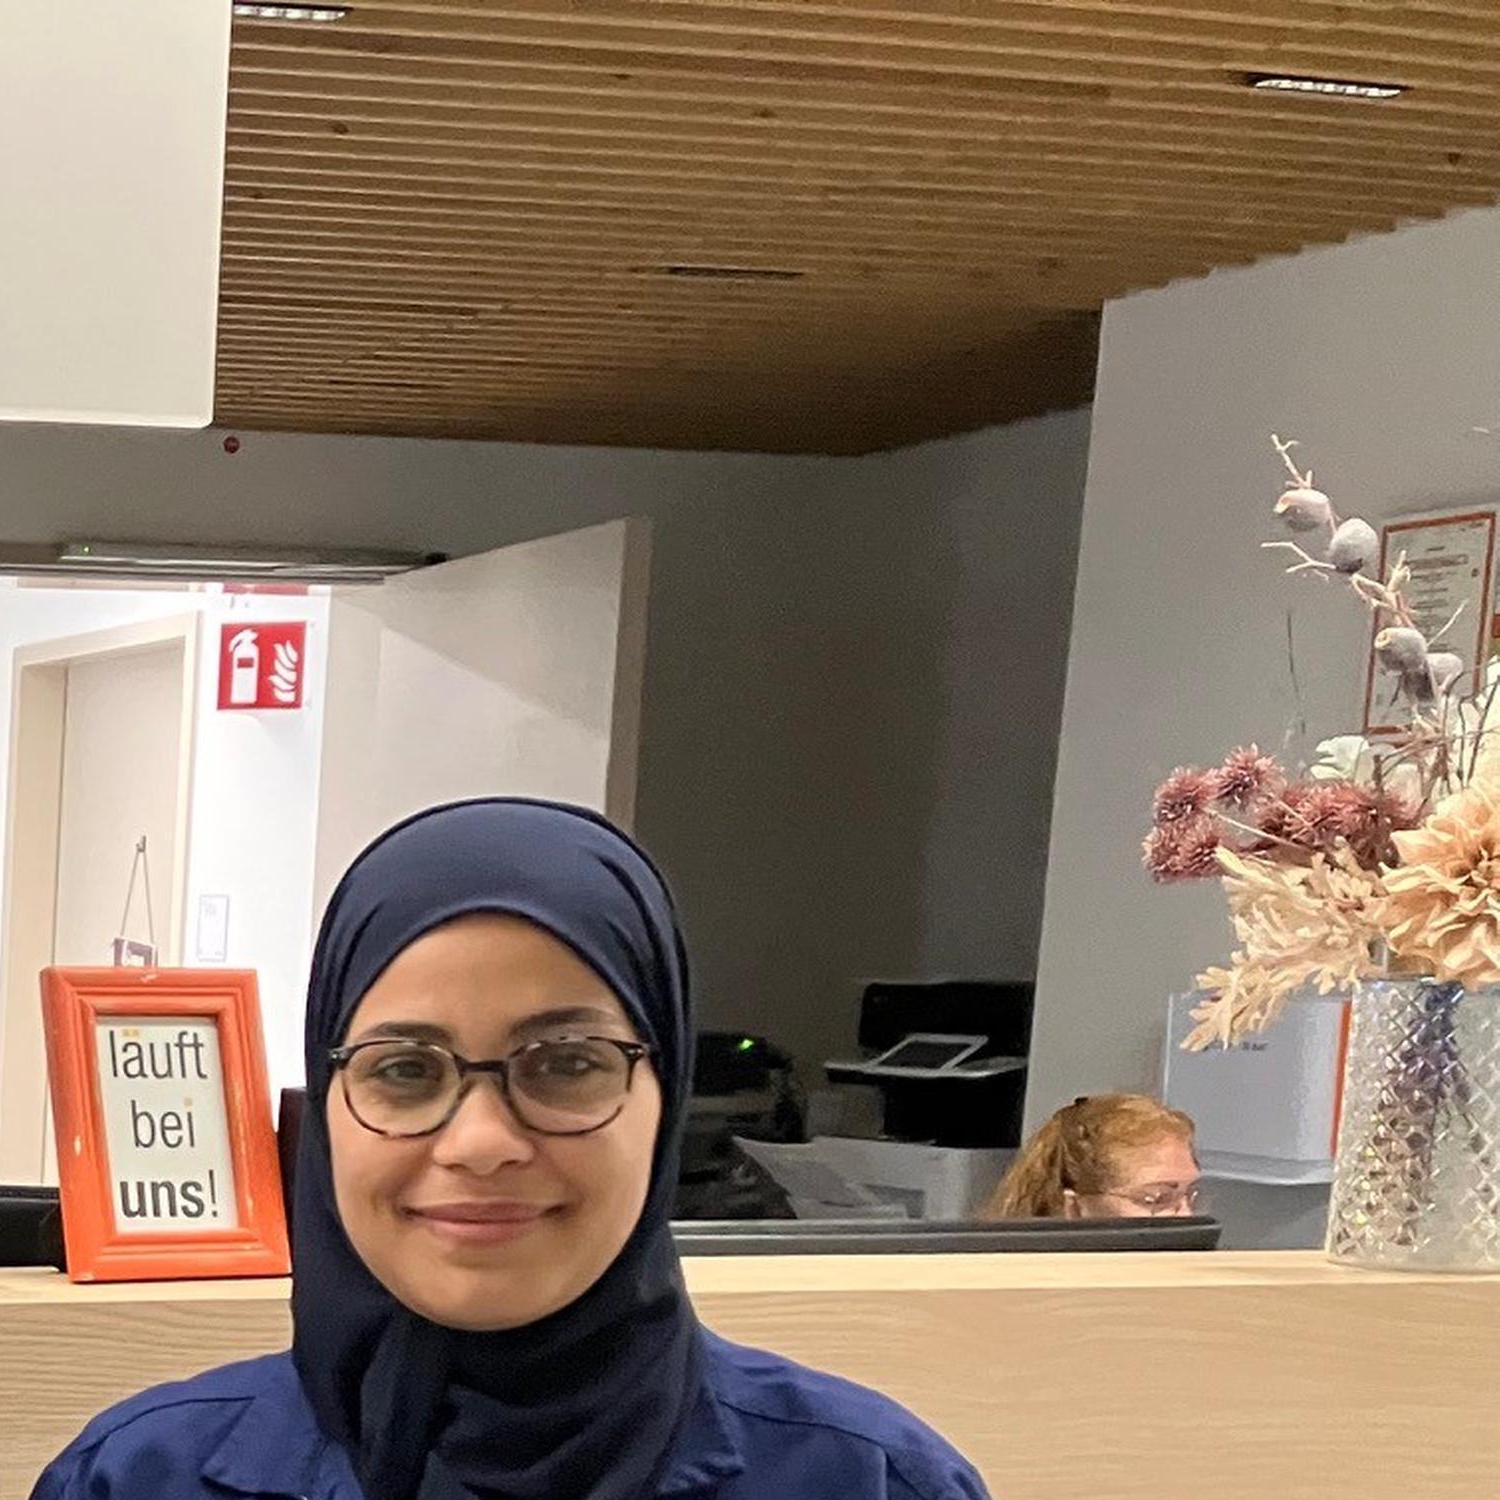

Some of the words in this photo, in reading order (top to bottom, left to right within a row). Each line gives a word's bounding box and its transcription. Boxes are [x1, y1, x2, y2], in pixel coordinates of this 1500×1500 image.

[108, 1028, 208, 1079] läuft
[130, 1097, 195, 1149] bei
[119, 1169, 218, 1219] uns!
